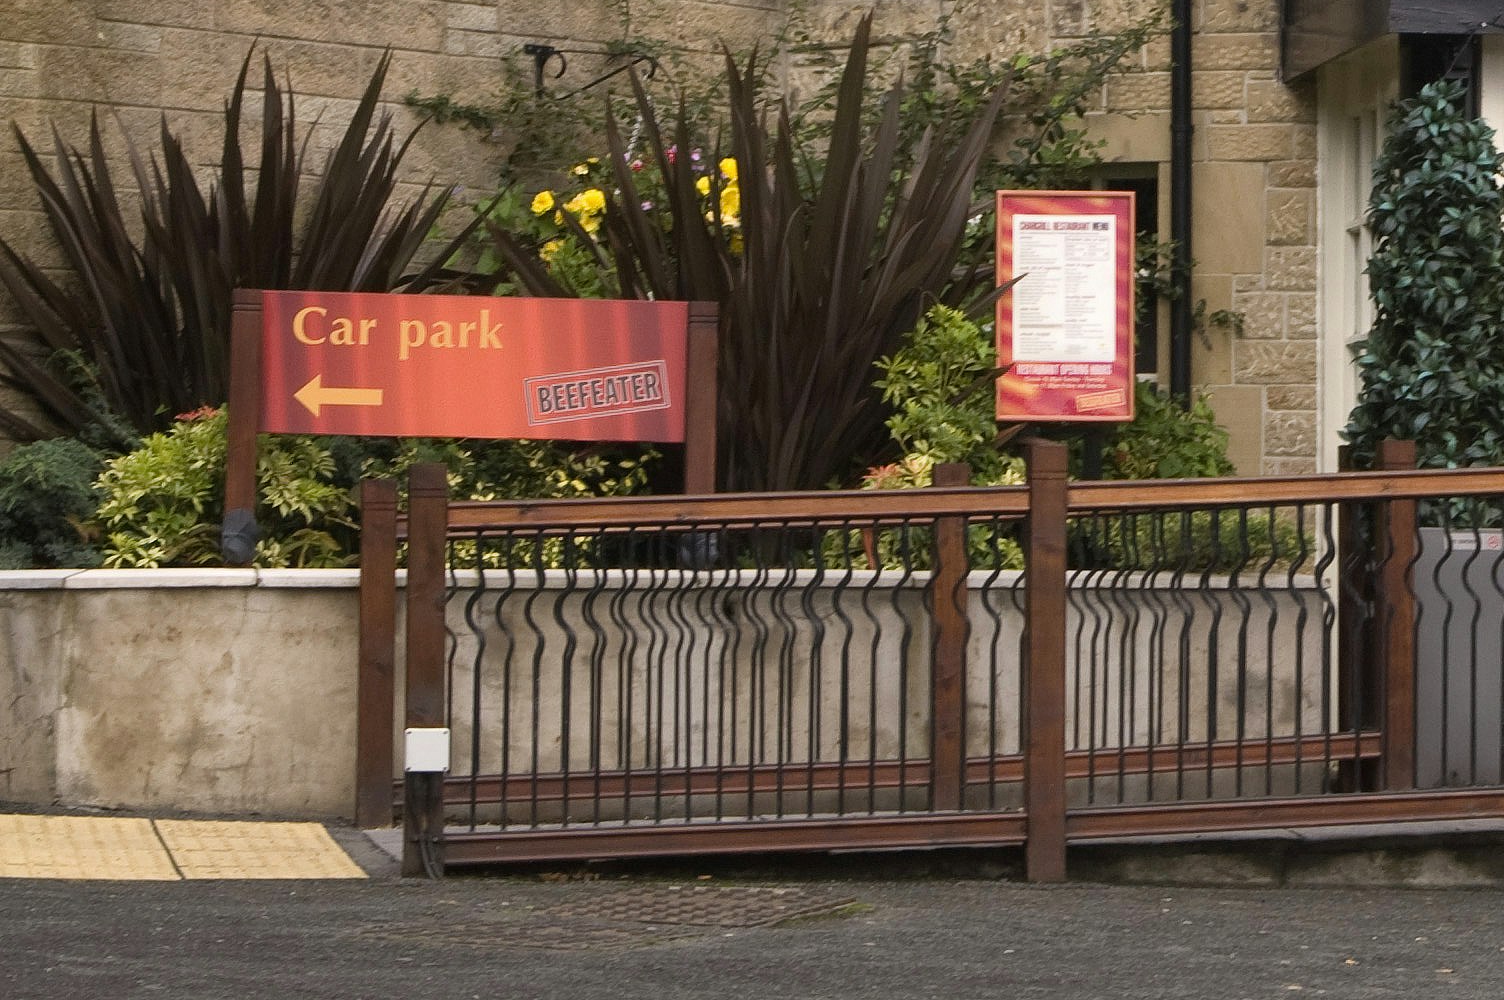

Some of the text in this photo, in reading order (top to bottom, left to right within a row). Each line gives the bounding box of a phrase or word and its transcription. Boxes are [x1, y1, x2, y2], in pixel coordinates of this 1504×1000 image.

[292, 306, 504, 360] Car park
[537, 371, 662, 415] BEEFEATER
